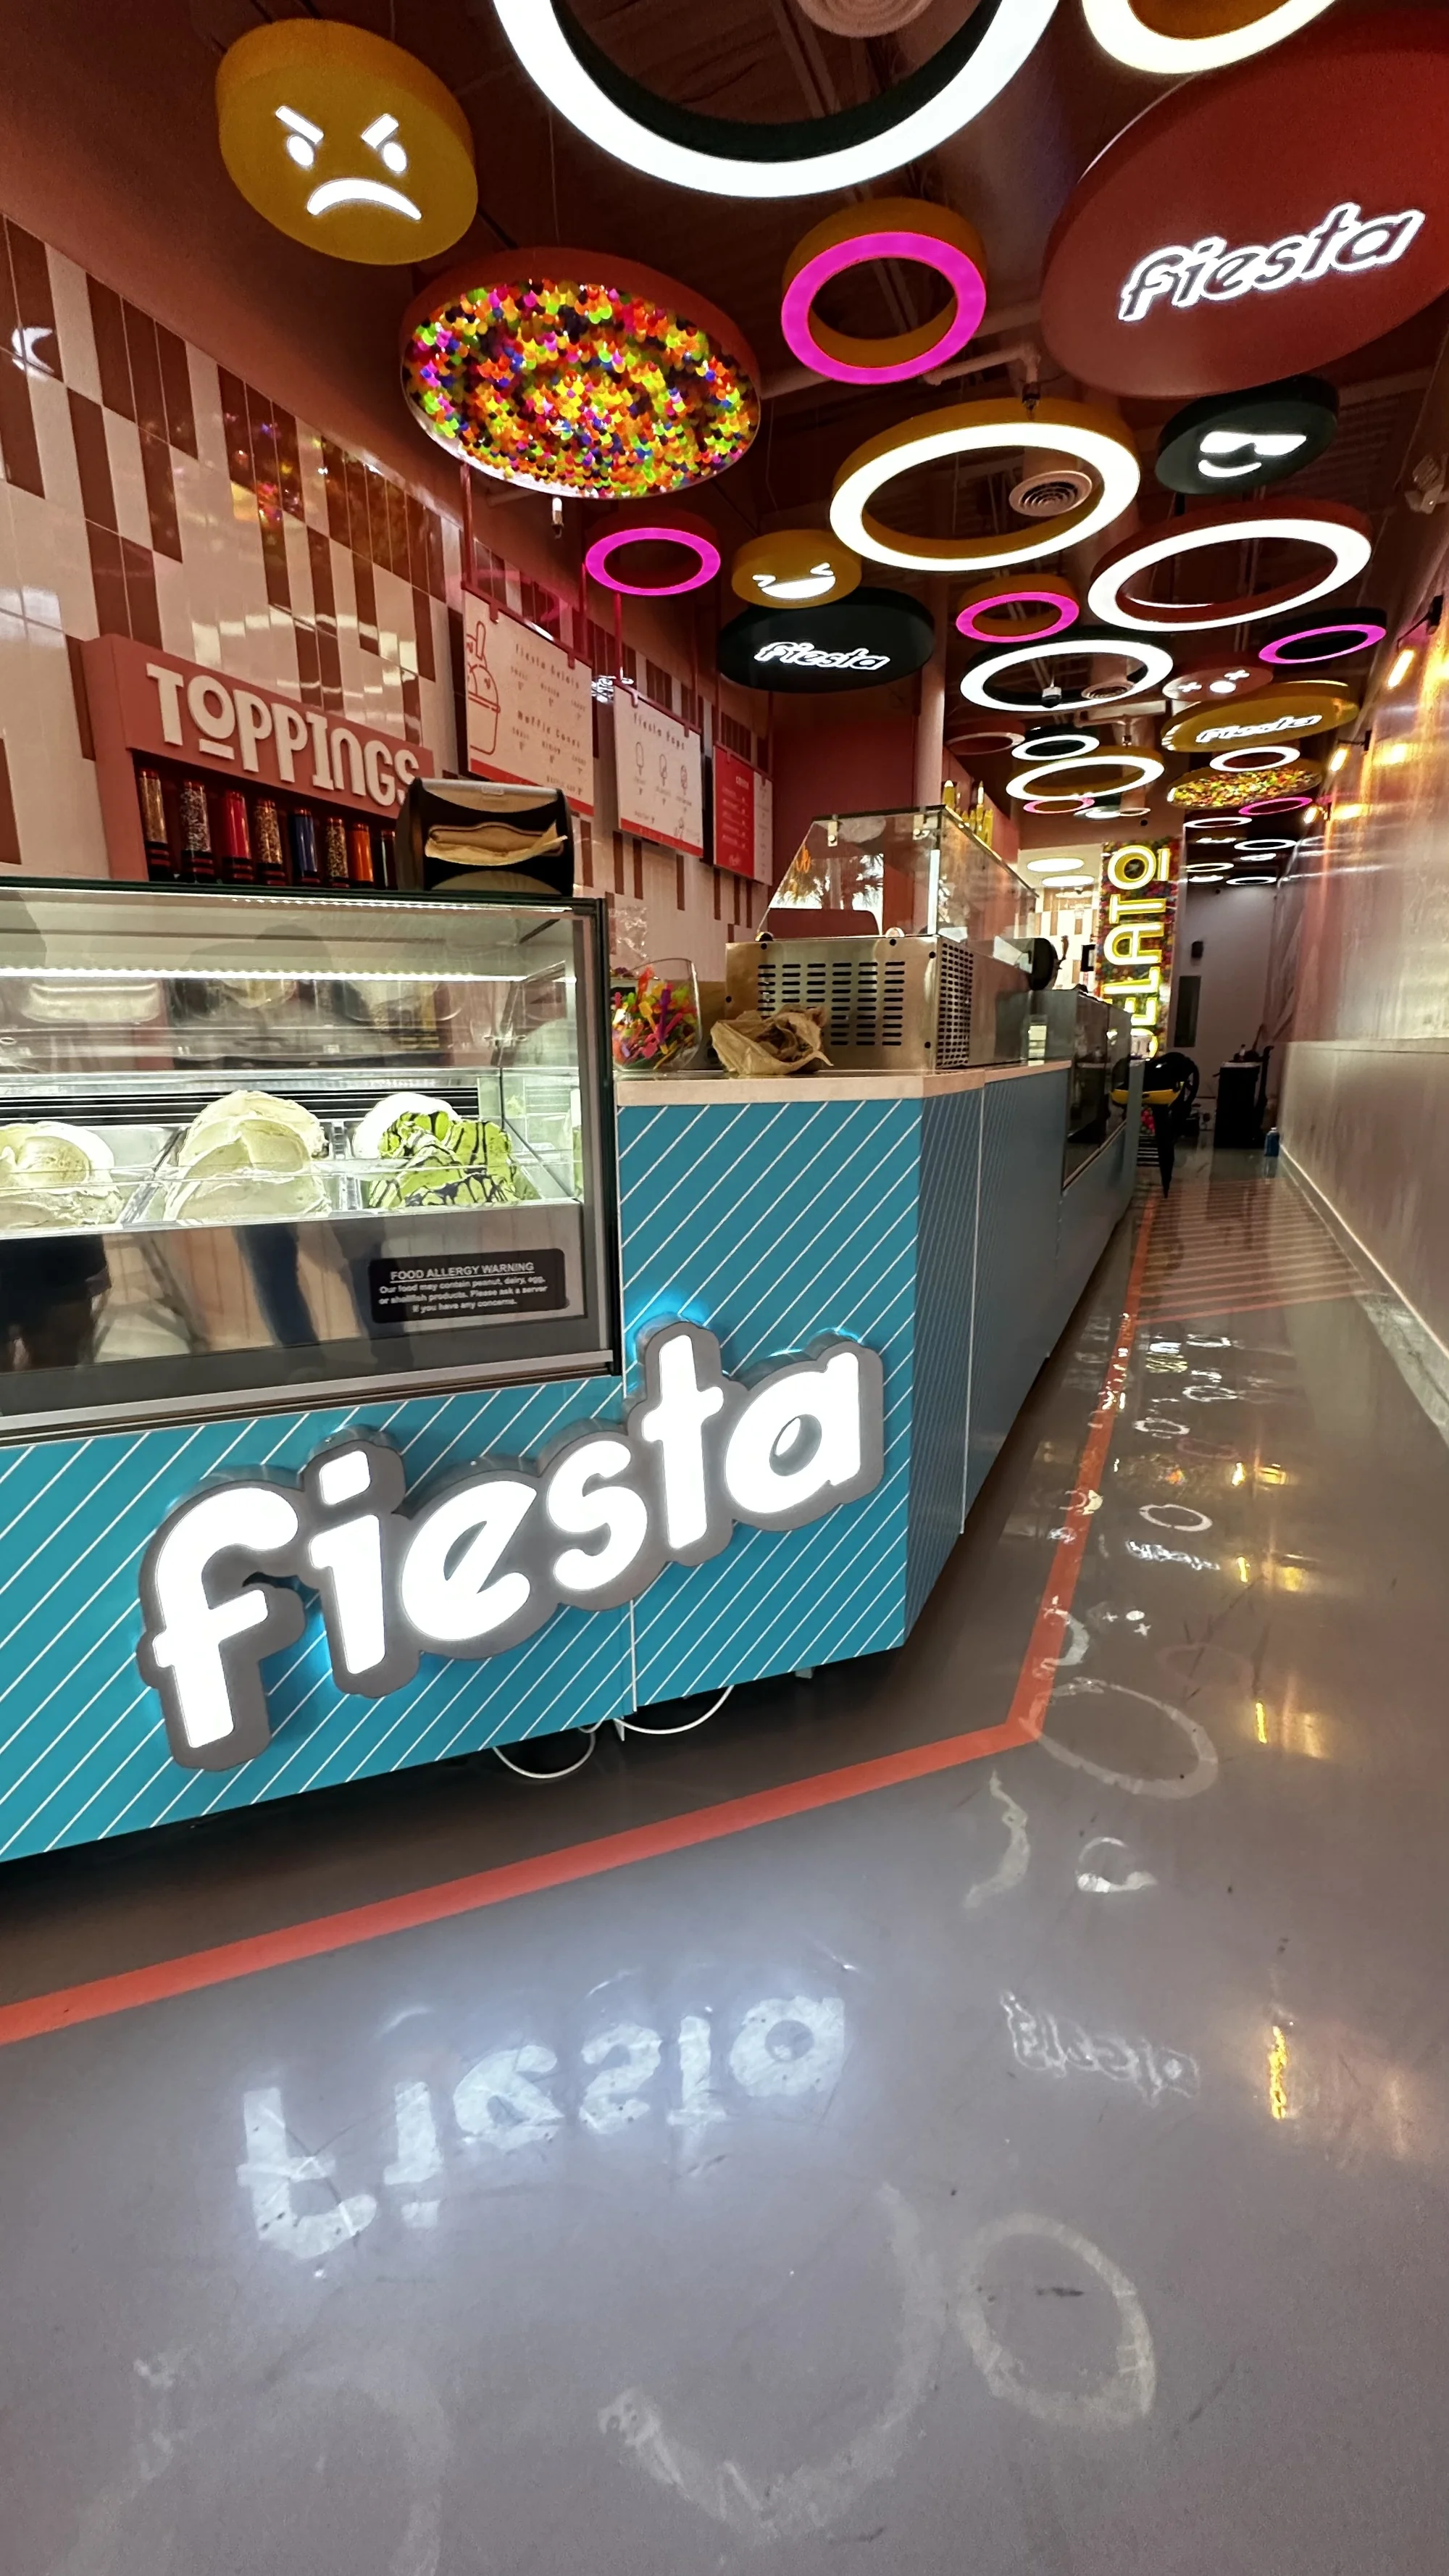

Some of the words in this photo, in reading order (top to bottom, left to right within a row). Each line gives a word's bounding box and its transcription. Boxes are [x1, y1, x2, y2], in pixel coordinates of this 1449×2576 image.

[1118, 201, 1426, 322] fiesta
[754, 641, 891, 671] fiesta
[146, 662, 419, 806] TOPPINGS
[391, 1270, 425, 1280] FOOD
[426, 1266, 480, 1278] ALLERGY
[481, 1262, 535, 1274] WARNING
[379, 1285, 397, 1294] Our
[439, 1280, 471, 1290] contain
[391, 1294, 427, 1304] shellfish
[469, 1289, 498, 1298] Please
[498, 1287, 514, 1296] ask
[420, 1305, 438, 1314] you
[150, 1332, 863, 1751] fiesta
